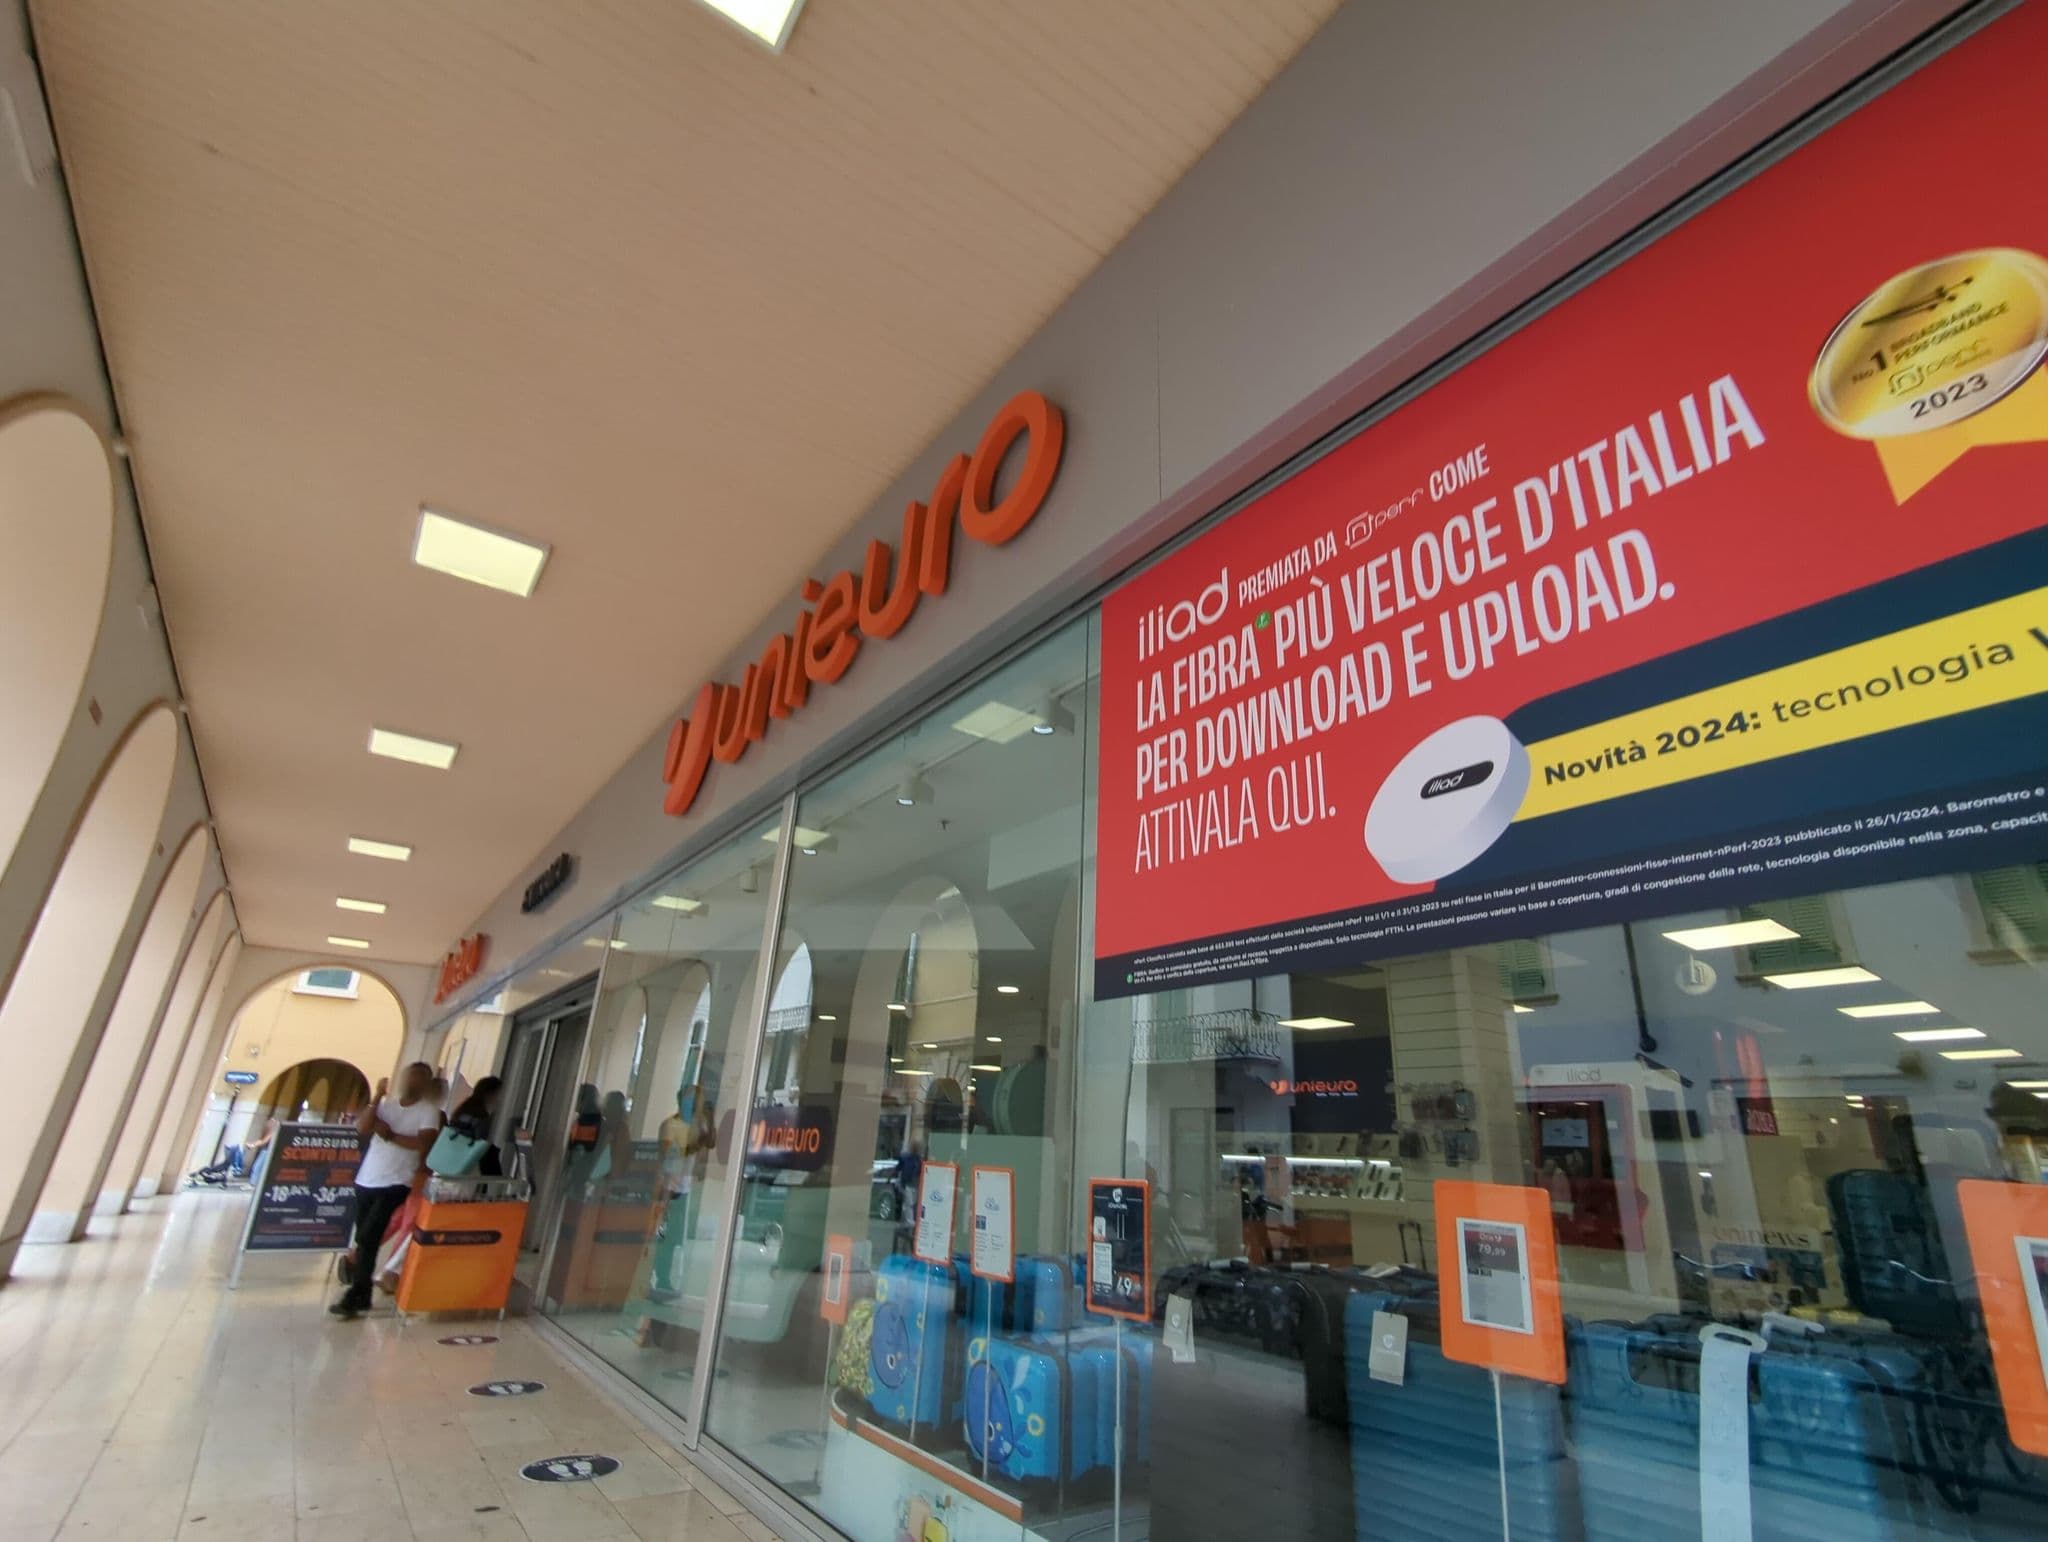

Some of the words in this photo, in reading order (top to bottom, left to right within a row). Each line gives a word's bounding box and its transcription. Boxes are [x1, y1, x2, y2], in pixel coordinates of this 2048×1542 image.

[1894, 301, 2009, 364] PERFORMANCE
[1910, 372, 1988, 419] 2023
[1136, 671, 1167, 734] LA
[1172, 624, 1261, 713] FIBRA
[1274, 577, 1334, 671] PIÙ
[1340, 496, 1507, 634] VELOCE
[1513, 373, 1767, 554] D'ITALIA
[1138, 567, 1228, 661] iliad
[1237, 542, 1312, 608] PREMIATA
[1314, 530, 1338, 565] DA
[1429, 443, 1490, 502] COME
[1136, 732, 1189, 801] PER
[1195, 641, 1393, 779] DOWNLOAD
[1403, 629, 1433, 699] E
[1440, 529, 1676, 681] UPLOAD.
[1543, 737, 1647, 787] Novità
[1656, 708, 1761, 756] 2024:
[1772, 642, 2015, 723] tecnologia
[1134, 781, 1259, 874] ATTIVALA
[1266, 751, 1337, 835] QUI.
[1428, 771, 1464, 795] iliad
[1335, 935, 1350, 943] Solo
[1350, 929, 1383, 941] tecnologia
[1384, 925, 1404, 935] FTTH.
[1416, 916, 1455, 930] prestazioni
[1456, 910, 1488, 923] possono
[1489, 905, 1516, 917] variare
[1528, 900, 1547, 910] base
[1556, 890, 1603, 905] copertura,
[1604, 885, 1629, 897] gradi
[1642, 872, 1705, 891] congestione
[1707, 867, 1734, 880] della
[1737, 862, 1763, 874] rete,
[1765, 850, 1830, 870] tecnologia
[1832, 837, 1905, 858] disponibile
[1908, 830, 1942, 845] nella
[1946, 823, 1987, 839] zona,
[1402, 906, 1420, 916] 31/12
[1420, 902, 1439, 912] 2023
[1450, 897, 1464, 907] reti
[1464, 894, 1482, 904] fisse
[1493, 888, 1513, 899] Italia
[1514, 885, 1528, 895] per
[1784, 823, 1852, 844] pubblicato
[1866, 805, 1943, 829] 26/1/2024.
[1946, 788, 2030, 813] Barometro
[292, 1136, 359, 1149] SAMSUNG
